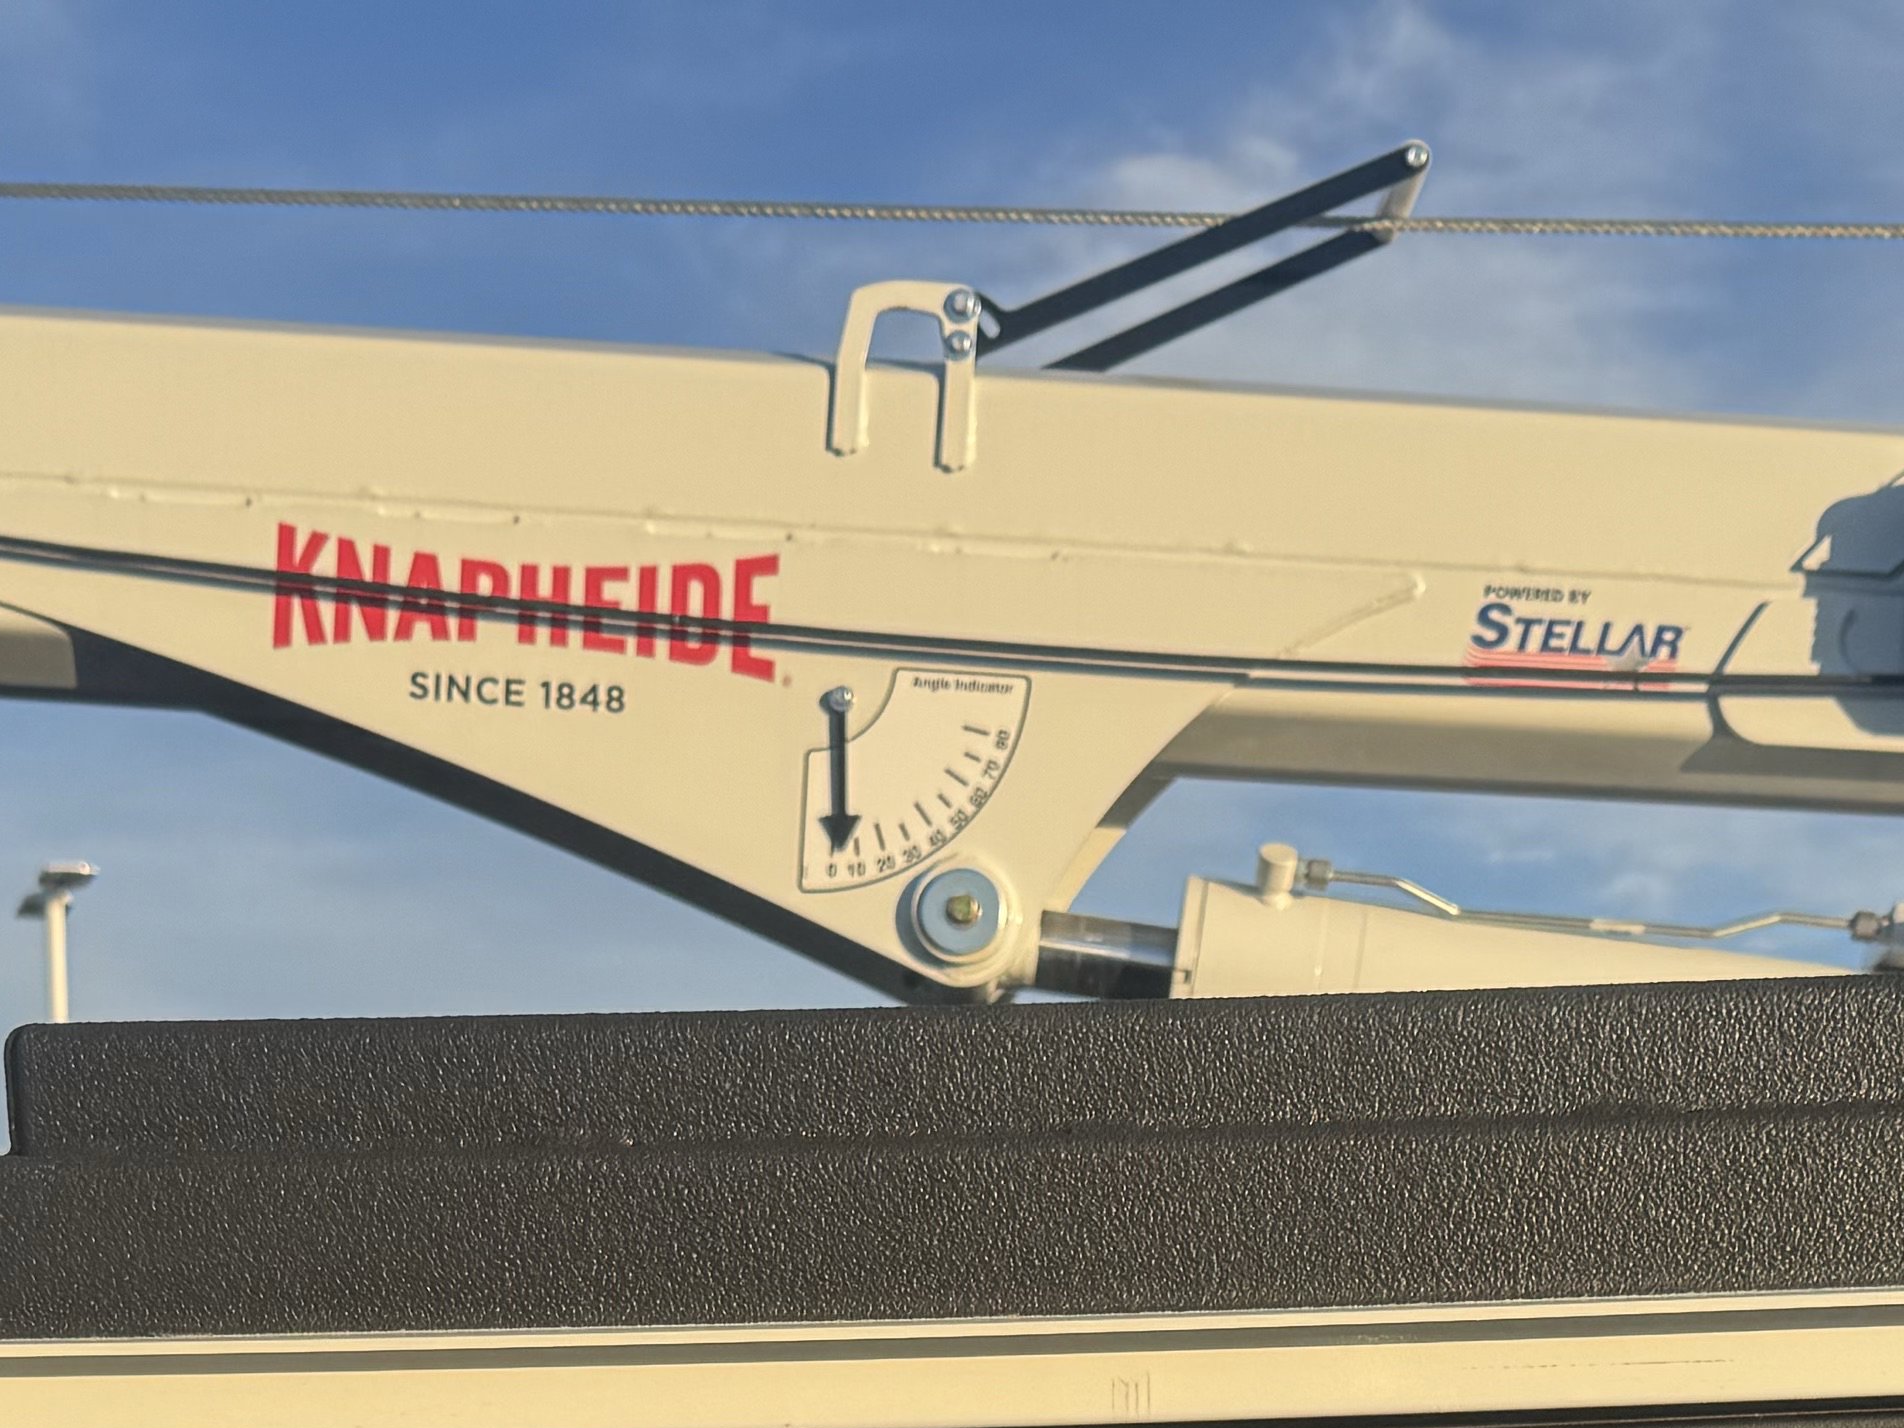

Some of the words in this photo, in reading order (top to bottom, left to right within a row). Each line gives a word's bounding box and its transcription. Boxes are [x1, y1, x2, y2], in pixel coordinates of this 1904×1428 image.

[272, 521, 781, 683] KNAPHEIDE
[1483, 585, 1565, 603] POWERED
[1568, 590, 1592, 605] BY
[1470, 601, 1684, 660] STELLAR
[409, 671, 526, 708] SINCE
[540, 681, 627, 715] 1848
[912, 676, 951, 693] Angle
[982, 760, 1001, 780] 70
[950, 810, 970, 831] 50
[825, 863, 838, 878] 0
[846, 863, 867, 877] 10
[876, 856, 896, 873] 20
